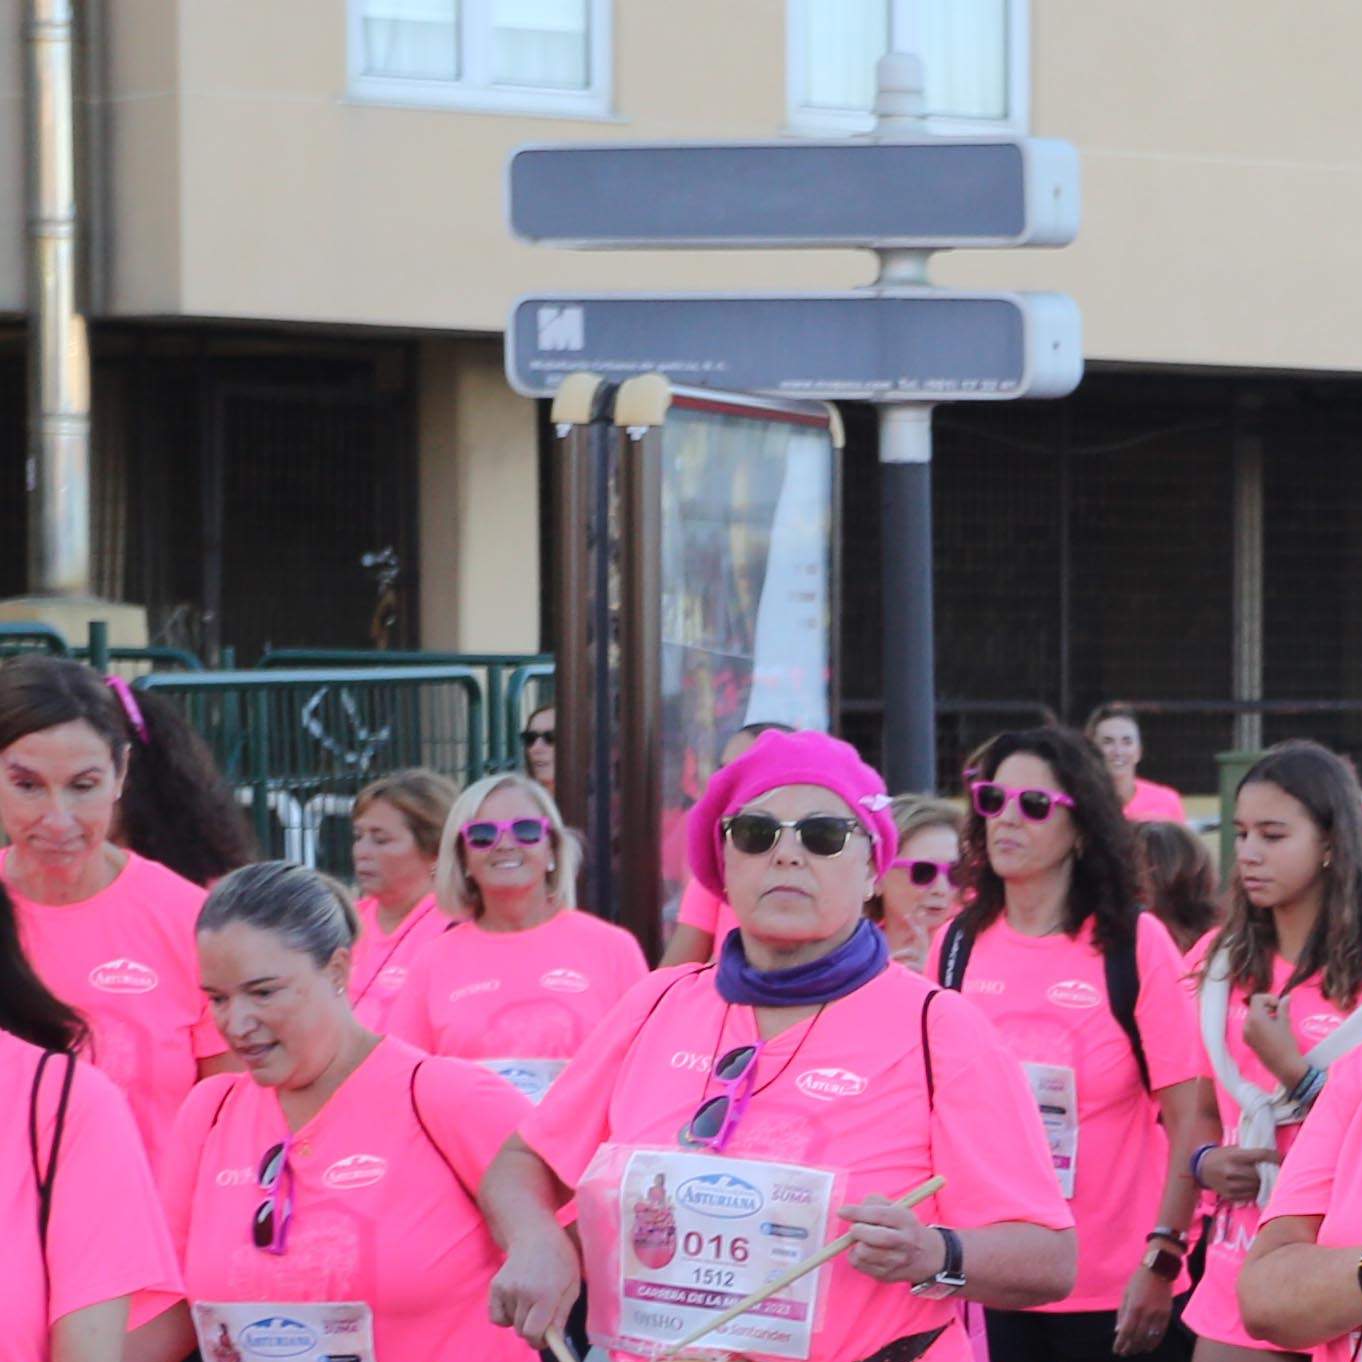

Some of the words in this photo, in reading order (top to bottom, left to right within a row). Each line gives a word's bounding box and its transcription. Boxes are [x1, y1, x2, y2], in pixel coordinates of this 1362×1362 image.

[671, 1051, 711, 1073] OYS
[684, 1186, 756, 1211] ASTURIANA
[682, 1231, 750, 1262] 016
[692, 1268, 735, 1288] 1512
